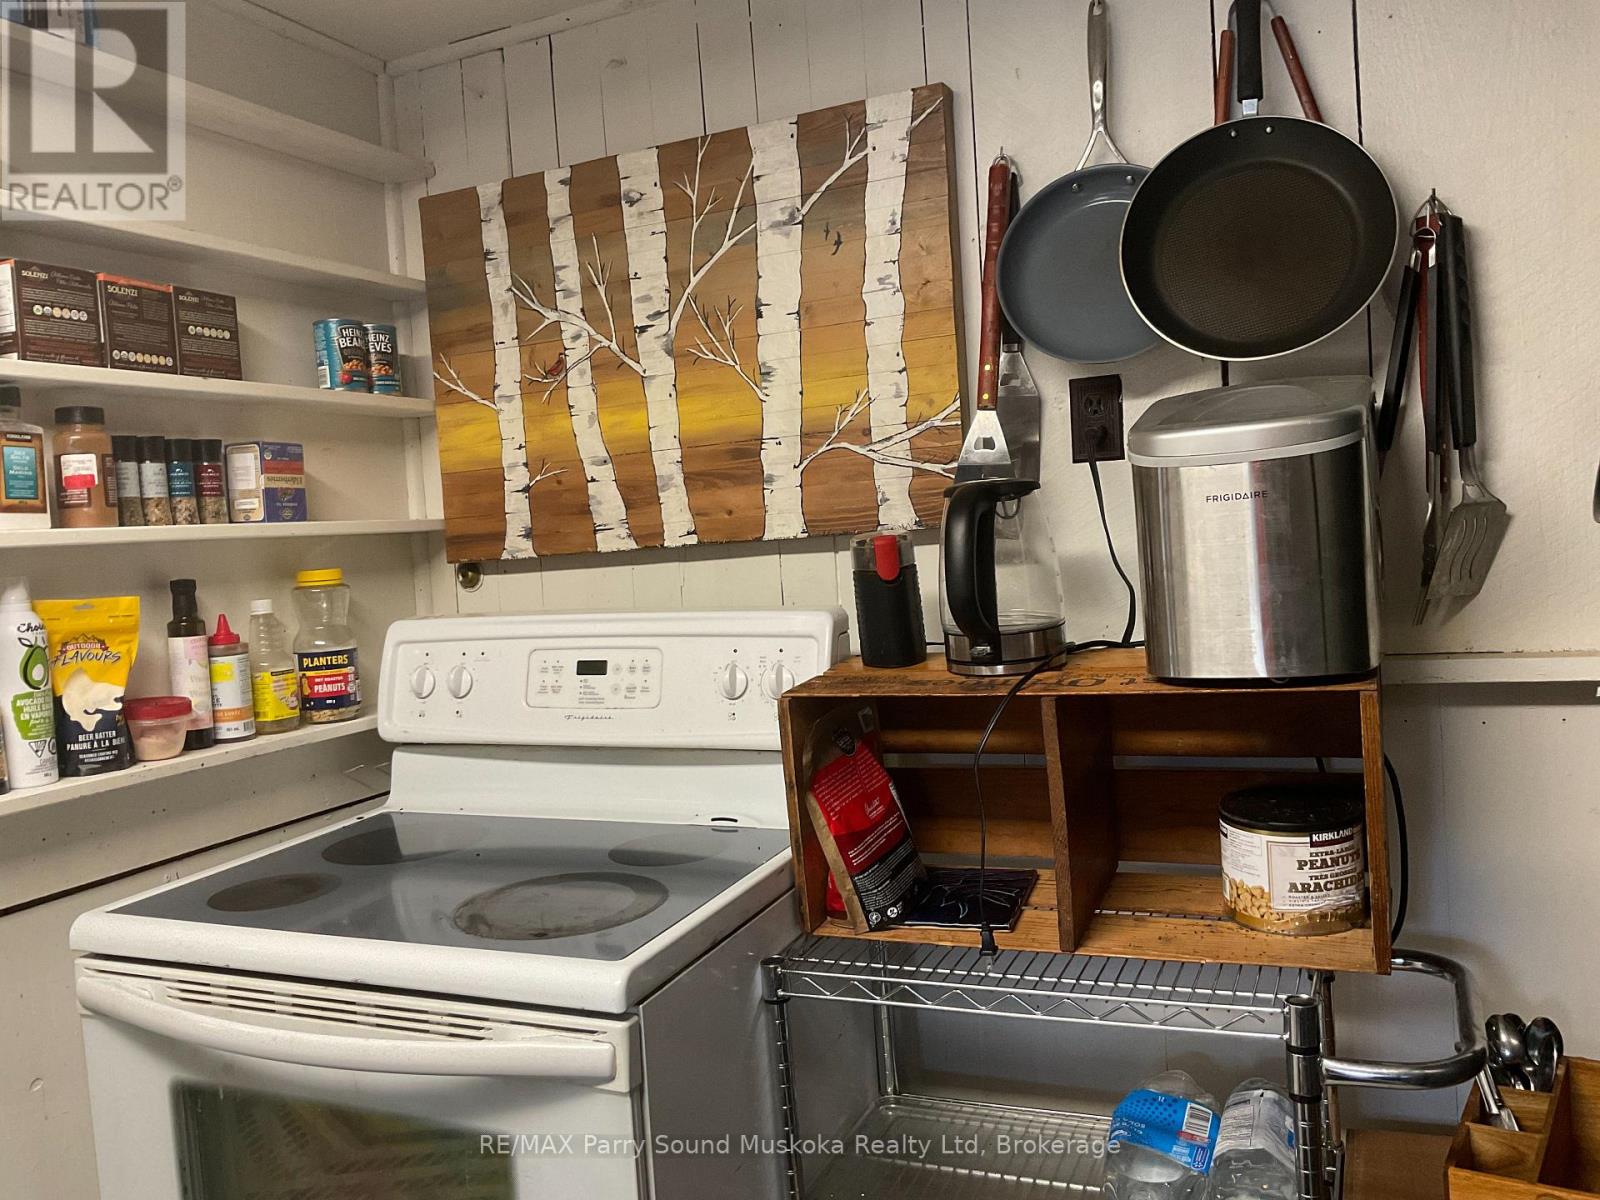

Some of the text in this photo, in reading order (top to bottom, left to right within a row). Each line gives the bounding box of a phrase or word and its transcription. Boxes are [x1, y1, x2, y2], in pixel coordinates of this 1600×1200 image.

[21, 269, 49, 280] SOLENZI
[106, 284, 138, 297] SOLENZI
[1205, 490, 1269, 503] FRIGIDAIRE
[66, 642, 101, 651] OUTDOOR
[51, 649, 121, 667] FLAVOURS
[303, 654, 349, 668] PLANTERS
[314, 682, 346, 693] PEANUTS
[78, 730, 117, 742] BEER BATTER
[66, 742, 92, 751] PANURE
[101, 739, 110, 748] LA
[1312, 827, 1353, 842] KIRKLAND
